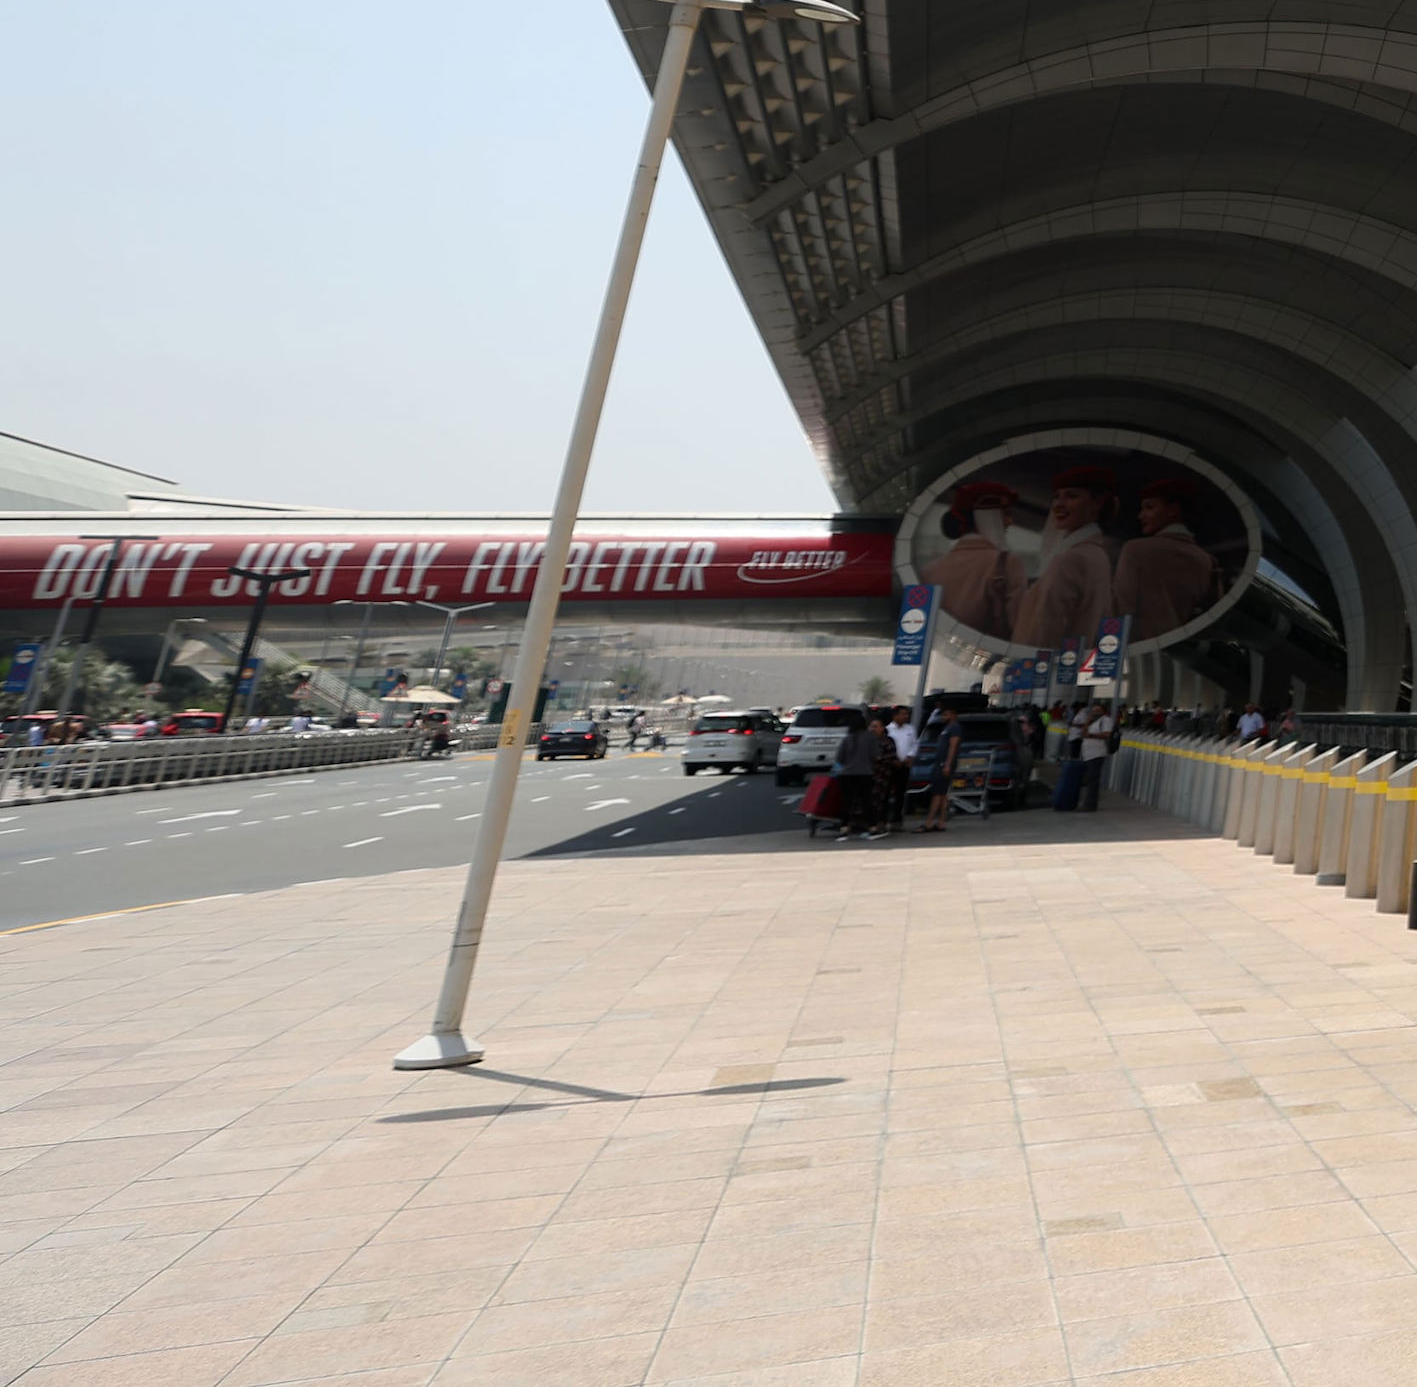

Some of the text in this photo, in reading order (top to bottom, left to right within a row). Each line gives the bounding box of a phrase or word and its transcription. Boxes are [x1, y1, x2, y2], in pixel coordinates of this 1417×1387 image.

[32, 542, 214, 599] DON'T
[209, 542, 355, 597] JUST
[356, 542, 447, 600] FLY,
[461, 541, 549, 594] FLY
[748, 550, 847, 570] FLY BETTER
